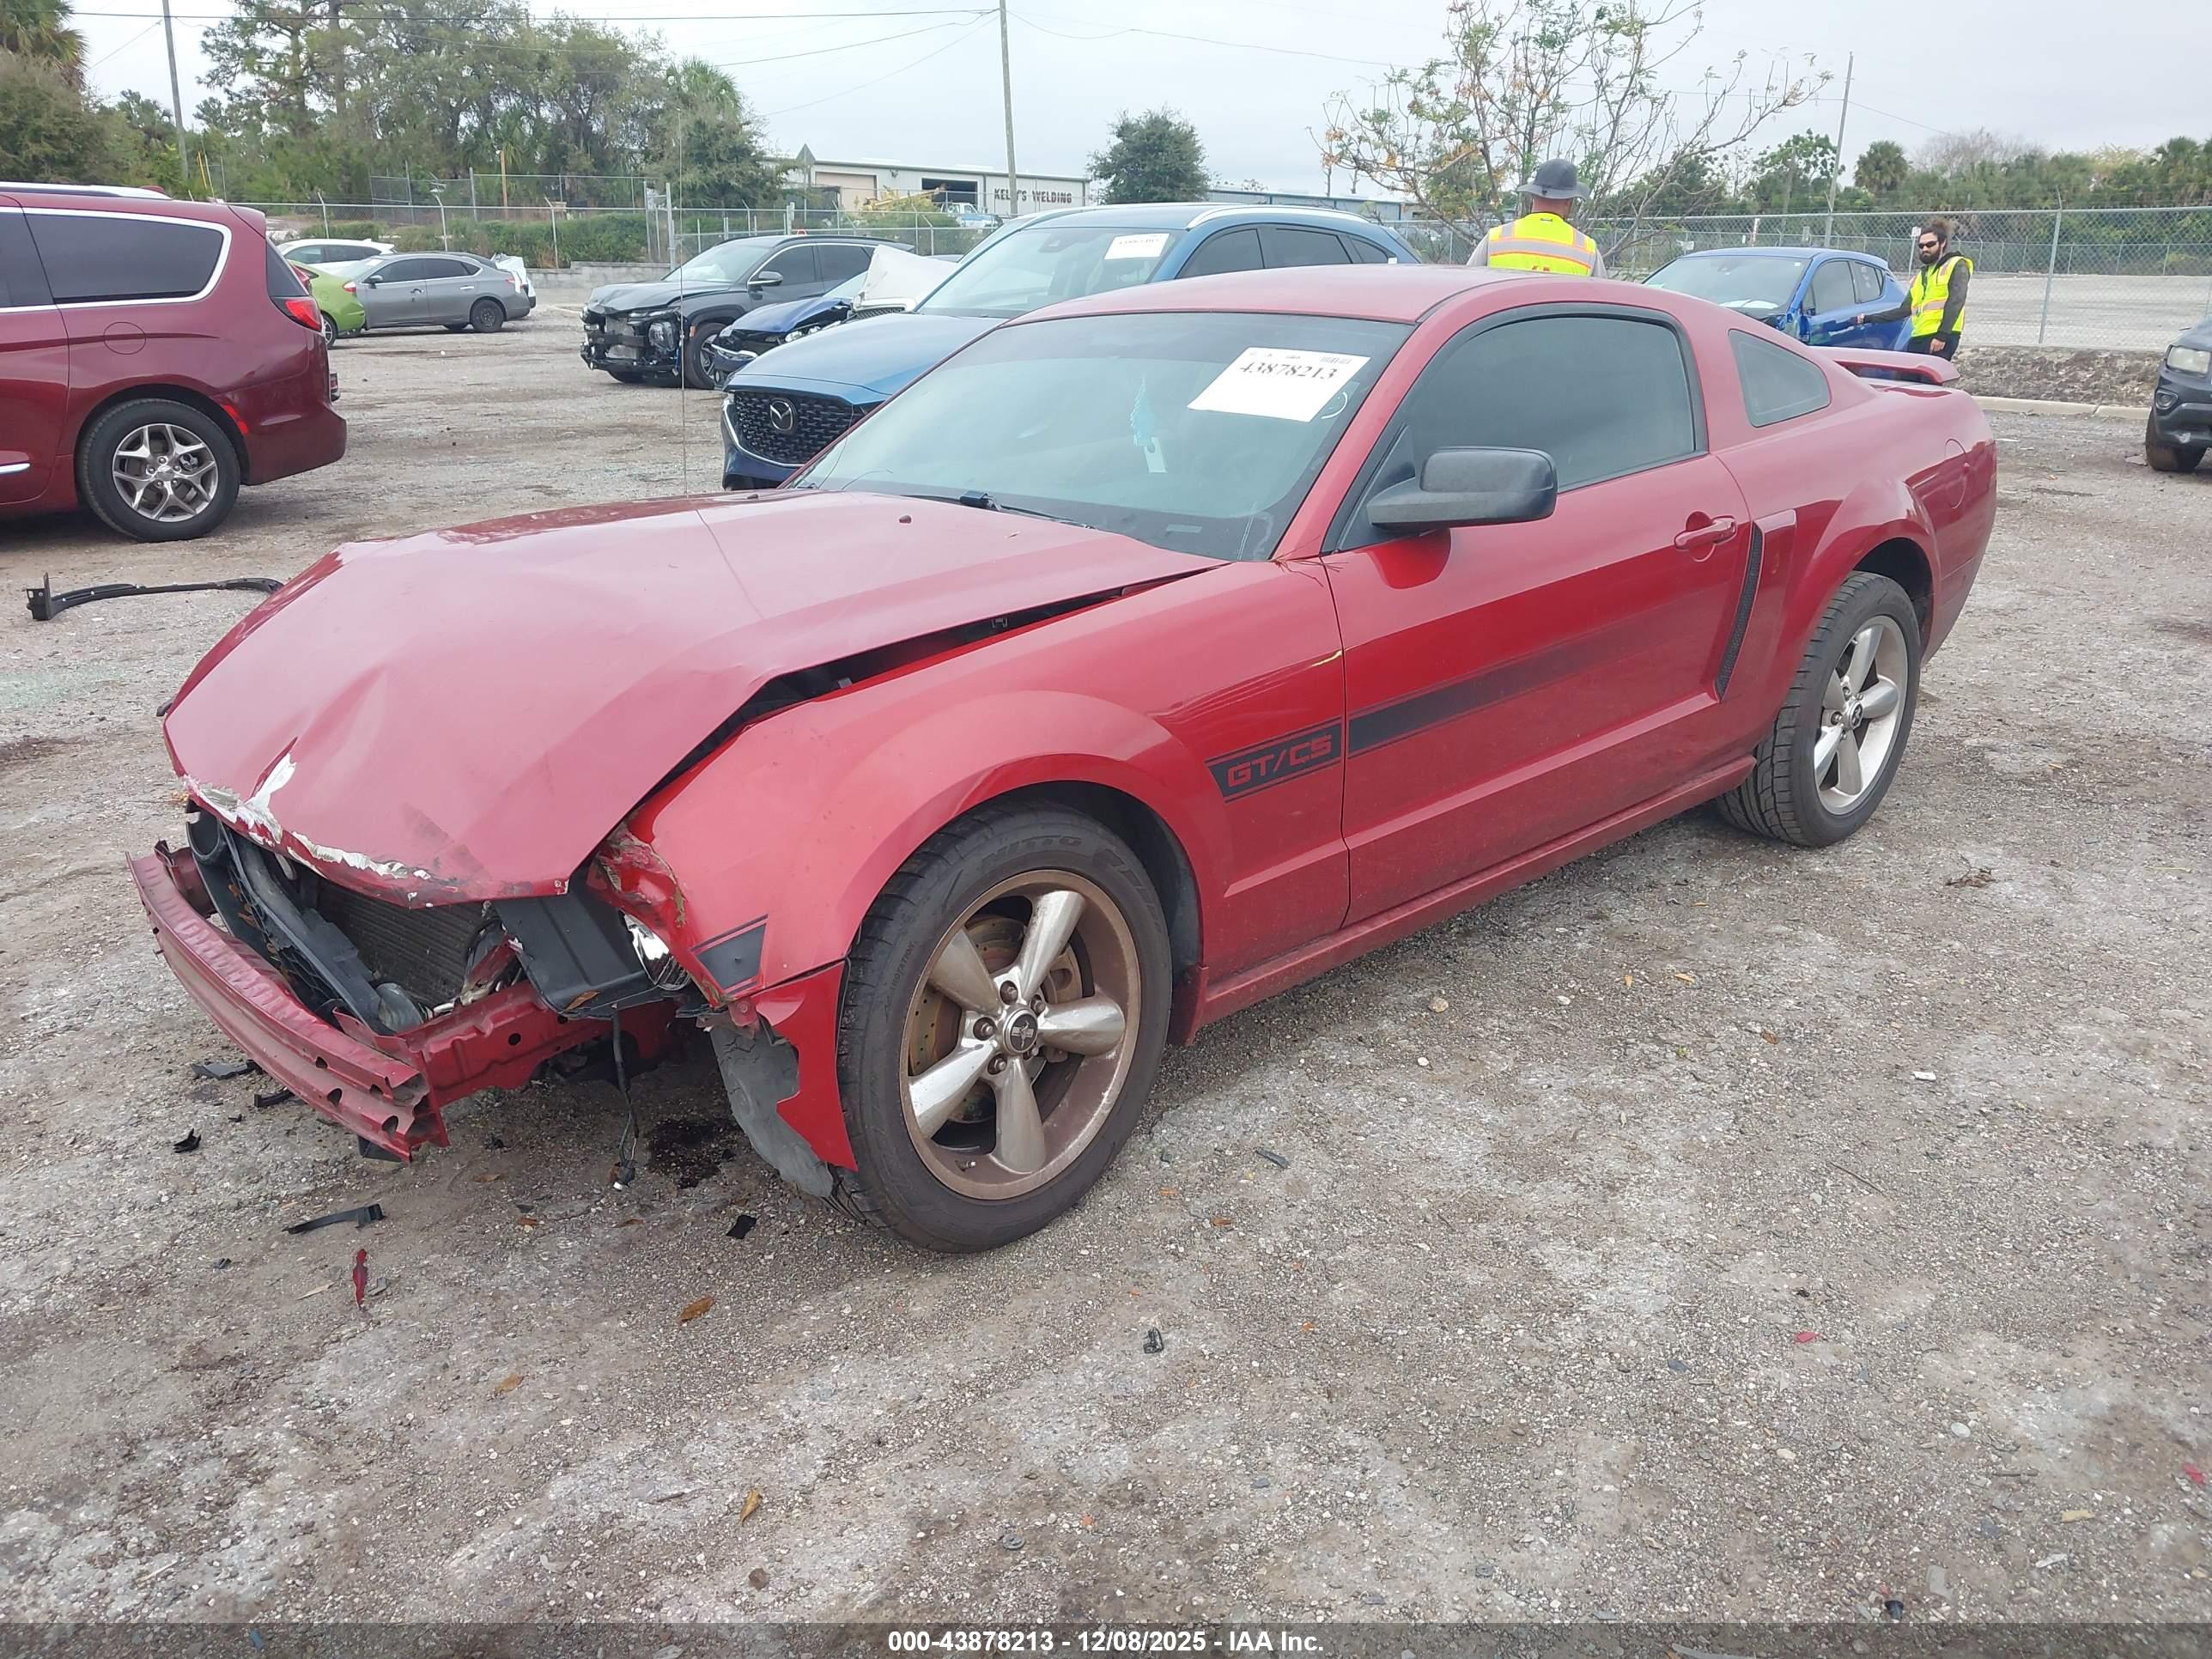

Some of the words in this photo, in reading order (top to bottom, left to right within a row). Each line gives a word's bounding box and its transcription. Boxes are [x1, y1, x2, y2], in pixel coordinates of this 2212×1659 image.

[994, 187, 1027, 201] KELY'S
[1032, 190, 1073, 204] WELDING
[1239, 362, 1338, 380] 43878213
[1227, 734, 1334, 787] GT/CS
